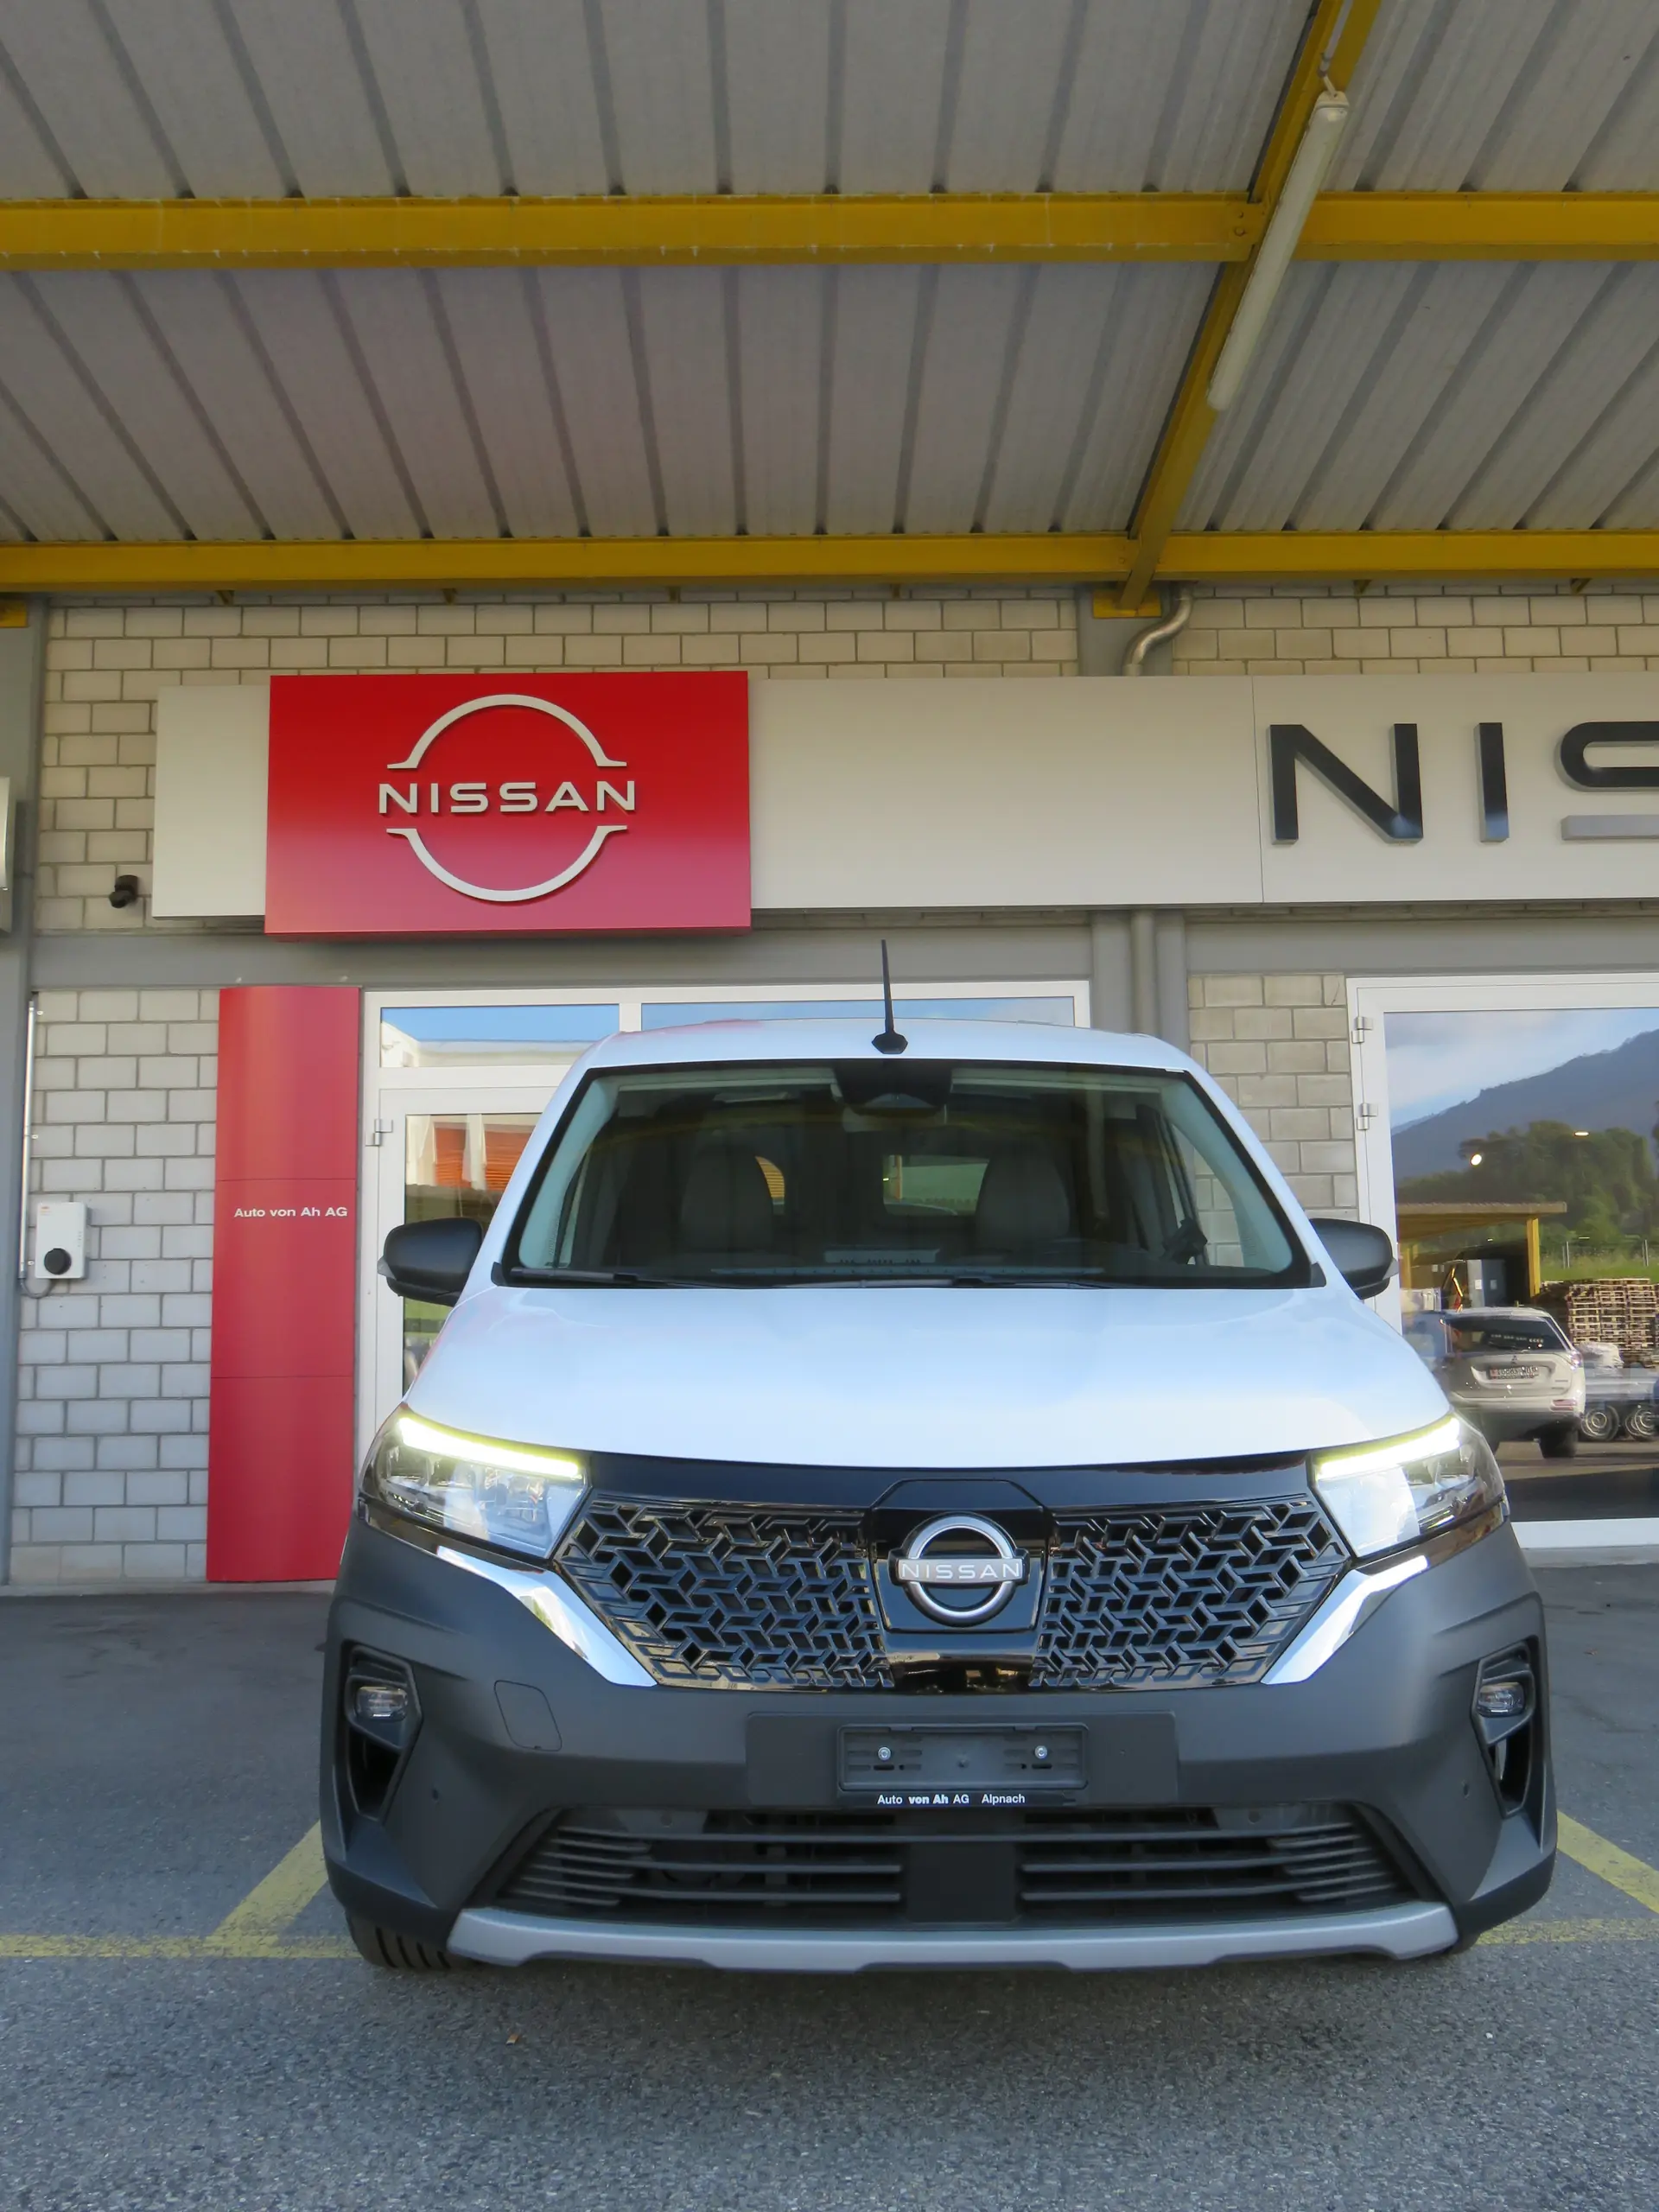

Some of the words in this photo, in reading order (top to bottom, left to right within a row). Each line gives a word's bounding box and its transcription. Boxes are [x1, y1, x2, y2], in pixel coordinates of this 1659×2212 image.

[378, 780, 636, 814] NISSAN
[234, 1208, 266, 1217] Auto
[270, 1209, 296, 1217] von
[300, 1206, 321, 1217] Ah
[325, 1206, 348, 1217] AG
[901, 1562, 1020, 1580] NISSAN
[877, 1794, 903, 1805] Auto
[908, 1796, 930, 1805] von
[932, 1794, 949, 1804] Ah
[953, 1794, 969, 1804] AG
[981, 1794, 1026, 1806] Alpnach
